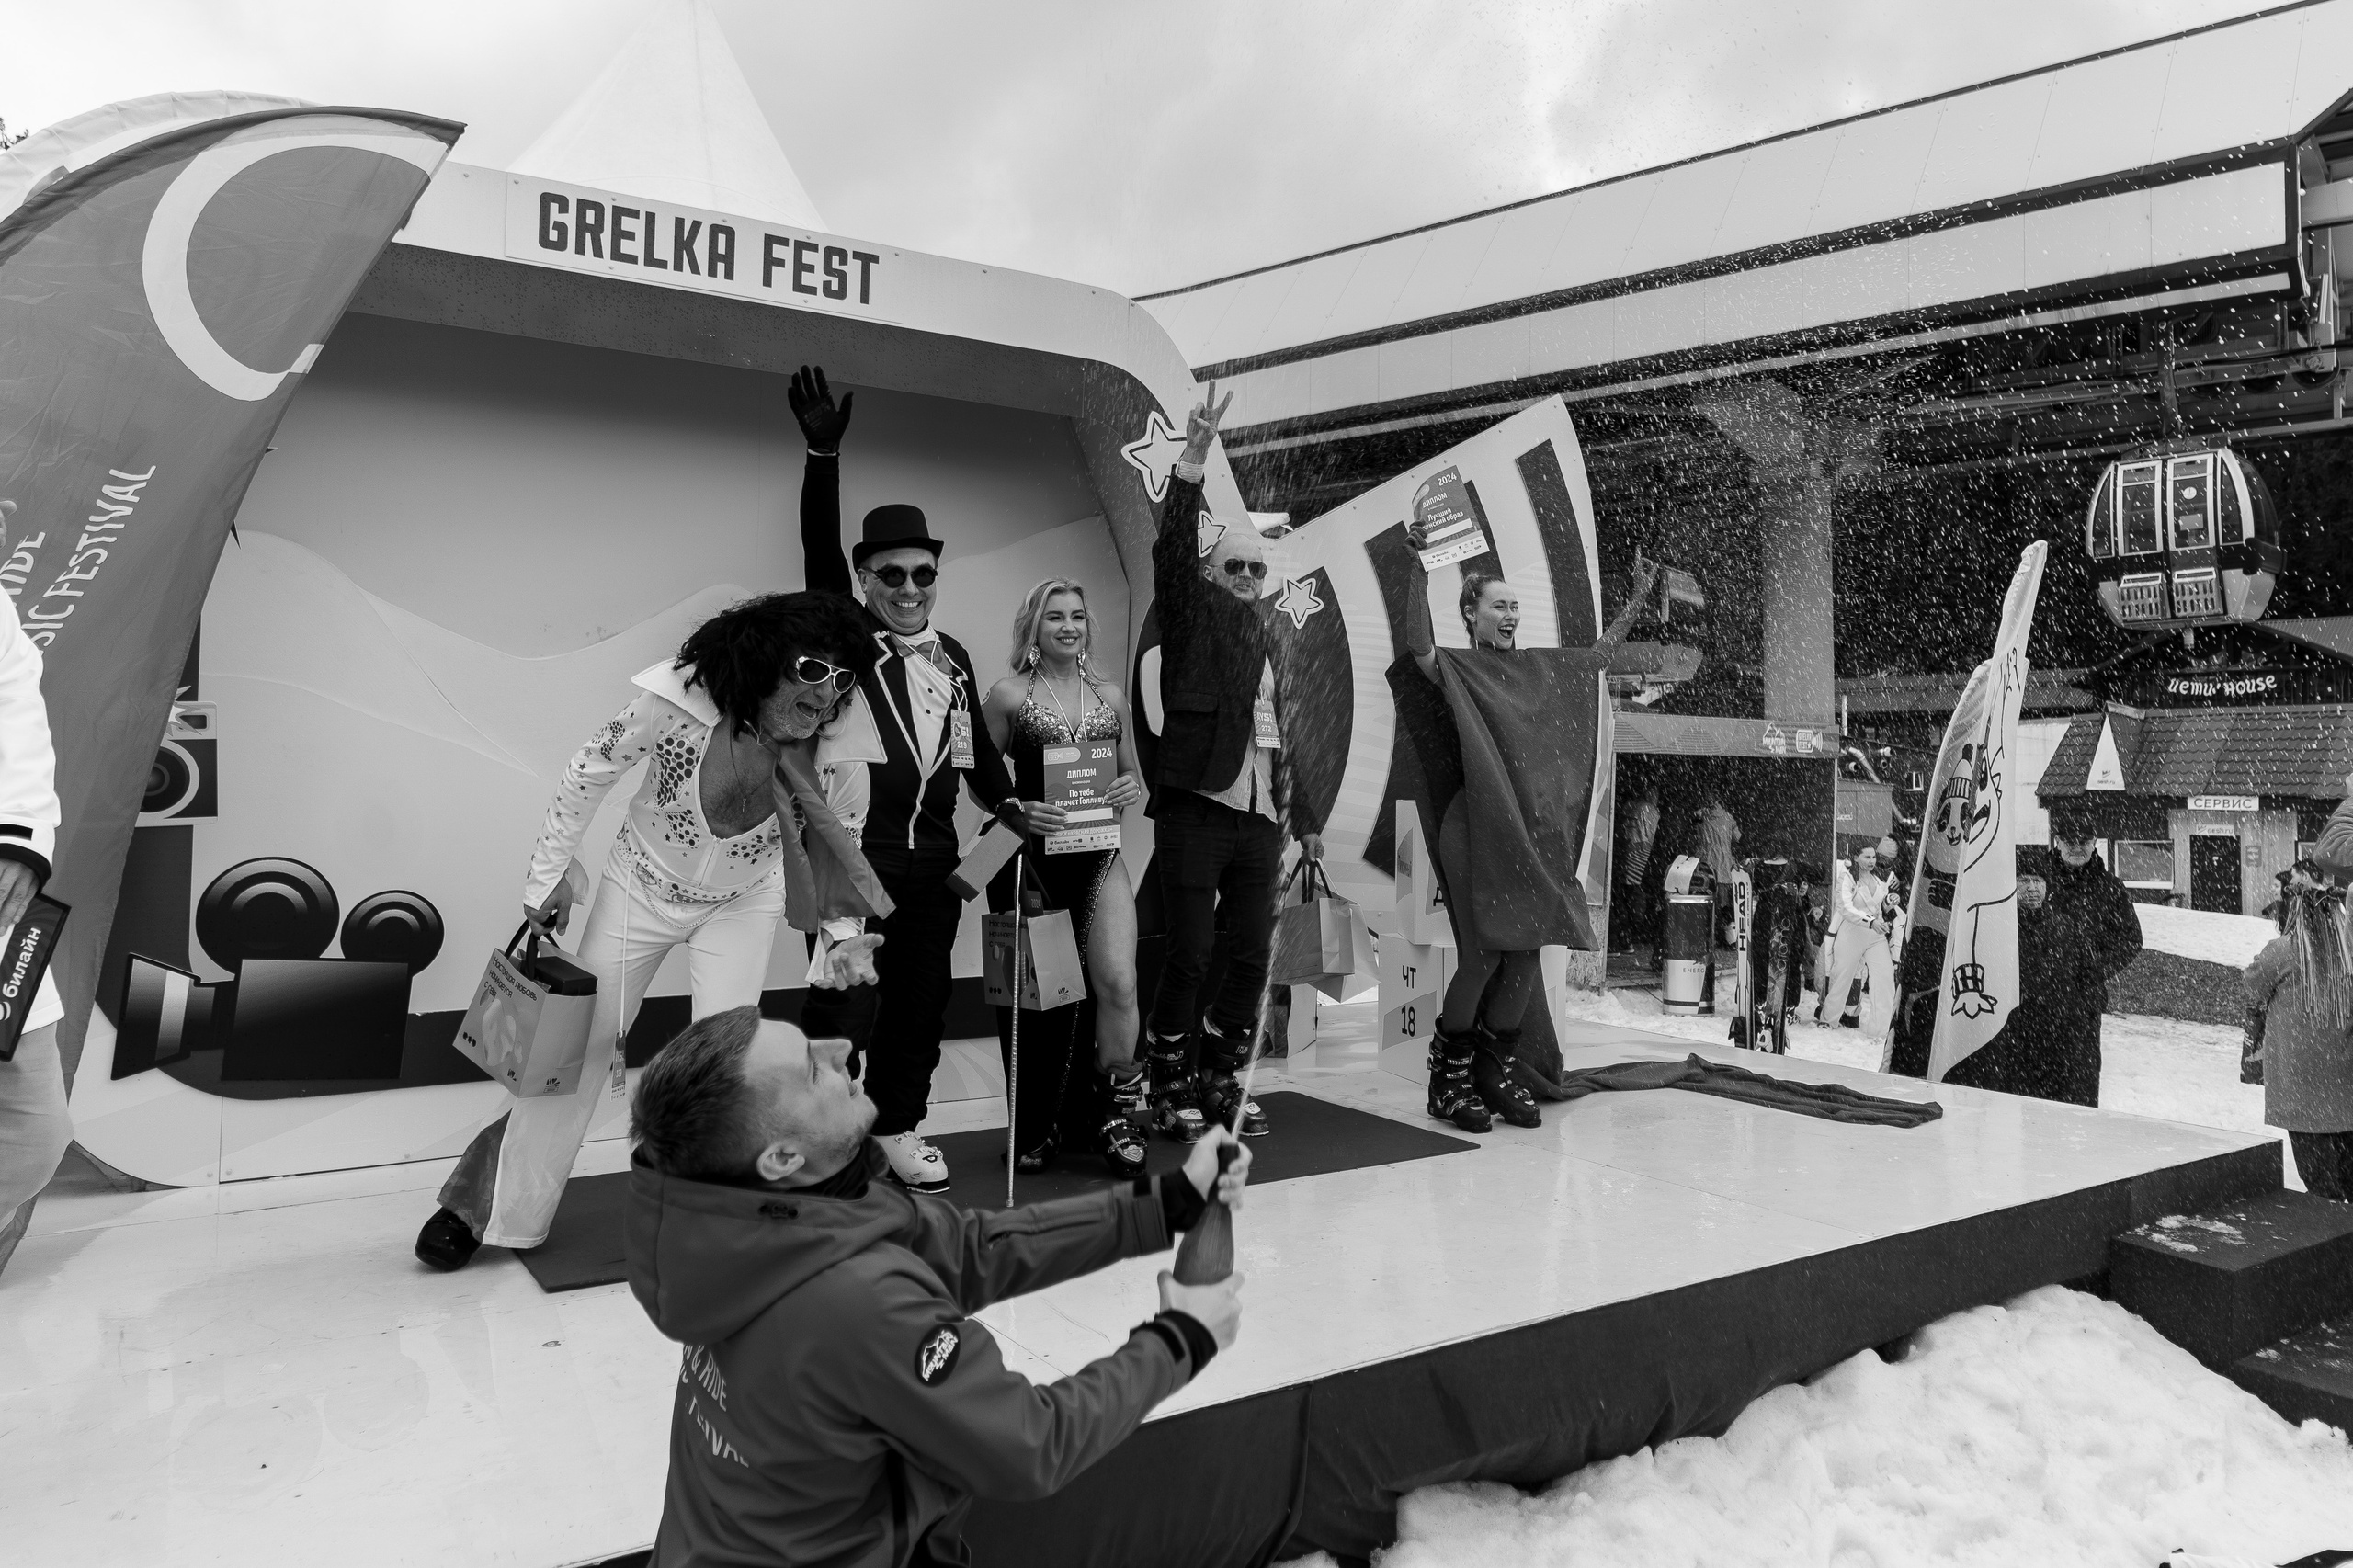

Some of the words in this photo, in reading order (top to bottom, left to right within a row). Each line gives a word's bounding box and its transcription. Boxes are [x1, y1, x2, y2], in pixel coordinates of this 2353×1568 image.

[539, 191, 735, 281] GRELKA
[762, 233, 880, 305] FEST
[1437, 472, 1457, 486] 2024
[1422, 492, 1448, 509] ДИПЛОМ
[1423, 517, 1447, 530] енский
[1446, 511, 1464, 522] образ
[1427, 507, 1452, 522] Лучший
[42, 465, 156, 597] FESTIVAL
[1261, 724, 1272, 733] 272
[957, 741, 968, 750] 219
[1091, 747, 1113, 759] 2024
[1066, 768, 1097, 778] ДИПЛОМ
[1069, 789, 1078, 798] По
[1079, 788, 1094, 797] тебе
[1055, 799, 1079, 808] плачет
[1079, 796, 1108, 806] Голливу
[2194, 797, 2252, 809] СЕРВИС
[3, 926, 42, 999] билайн
[1402, 965, 1417, 990] ЧТ
[1401, 1006, 1416, 1038] 18
[698, 1352, 727, 1413] RIDE
